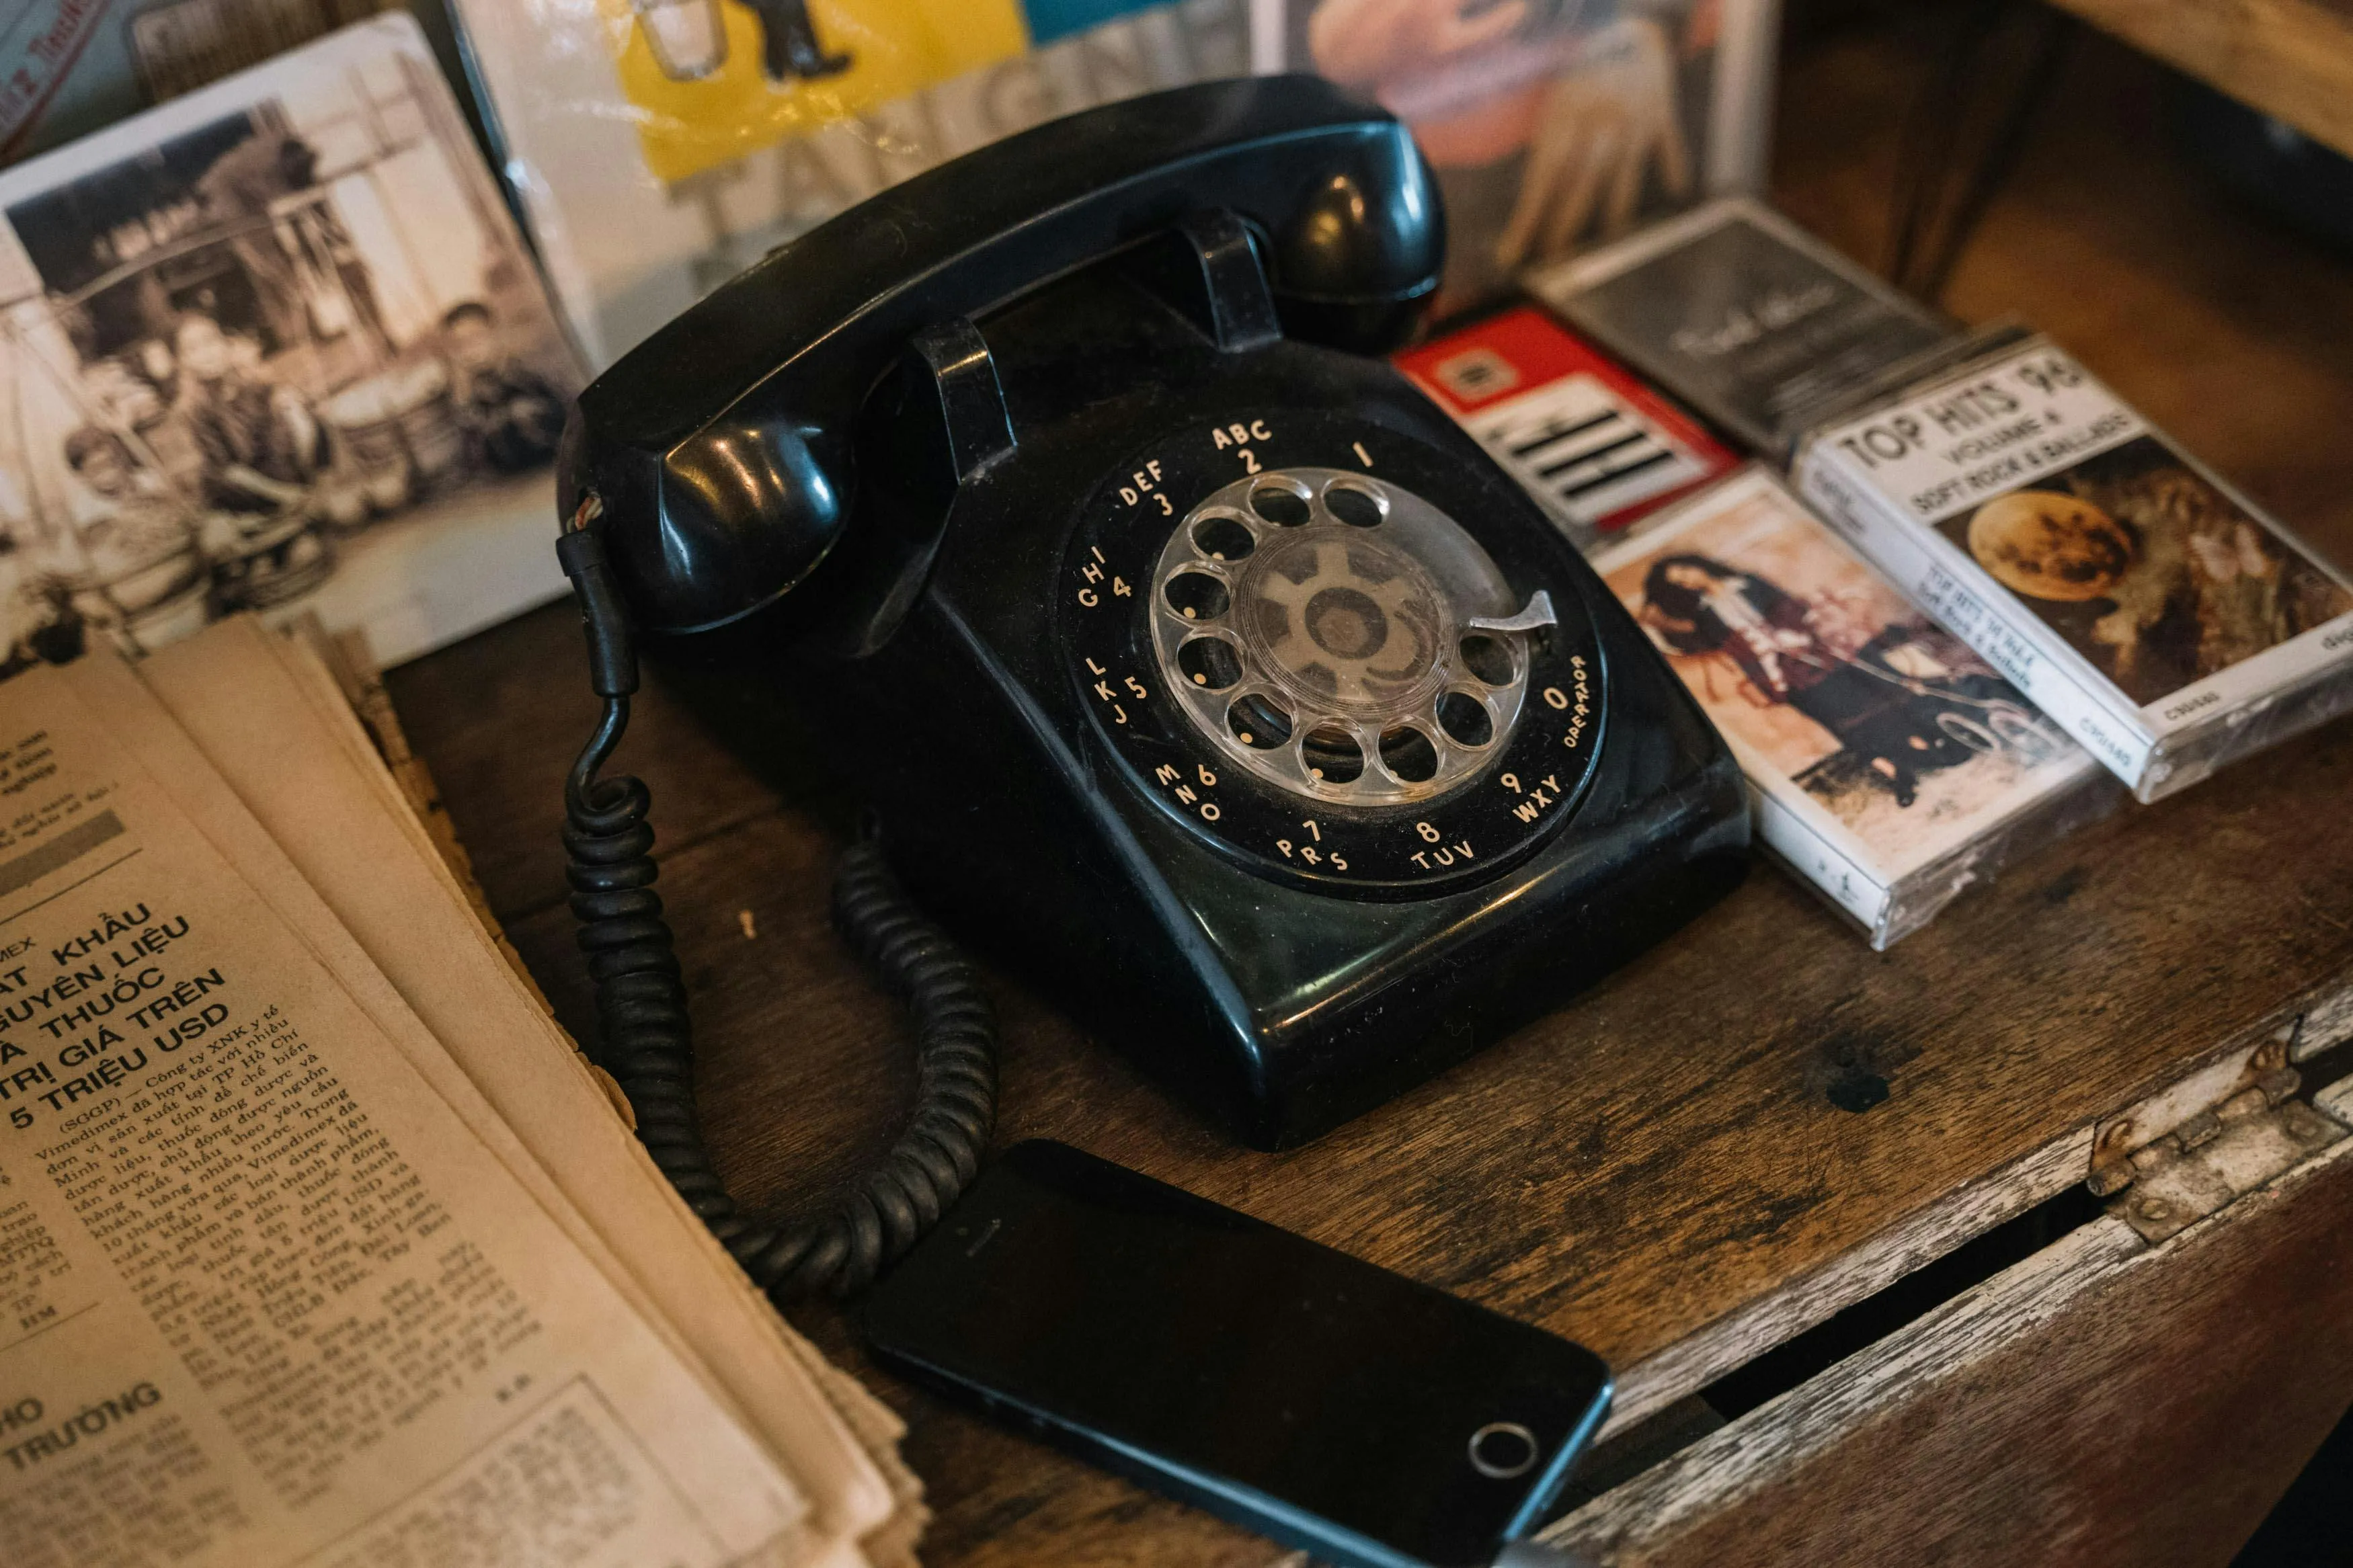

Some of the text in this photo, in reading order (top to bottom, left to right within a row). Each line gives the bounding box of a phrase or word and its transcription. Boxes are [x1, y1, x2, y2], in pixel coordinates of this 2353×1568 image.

[1212, 419, 1272, 450] ABC
[1837, 414, 1925, 468] TOP
[1923, 381, 2021, 436] HITS
[1946, 417, 2042, 466] VOLUME
[1238, 448, 1263, 474] 2
[1352, 441, 1373, 468] 1
[1911, 478, 1960, 515] SOFT
[1964, 456, 2022, 490] ROCK
[2039, 412, 2130, 458] BALLADS
[1119, 459, 1162, 507] DEF
[1153, 493, 1173, 516] 3
[1113, 576, 1131, 597] 4
[1125, 676, 1147, 699] 5
[1564, 655, 1590, 748] OPERATOR
[1198, 764, 1217, 786] 6
[1501, 773, 1522, 794] 9
[1512, 774, 1561, 823] WXY
[1275, 839, 1347, 870] PRS
[1302, 819, 1321, 842] 7
[1416, 821, 1440, 843] 8
[1410, 841, 1474, 870] TUV
[52, 903, 151, 966] KHẨU
[111, 915, 190, 968] LIỆU
[38, 967, 165, 1038] THUỐC
[58, 1024, 126, 1067] GIÁ
[126, 968, 227, 1030] TRÊN
[9, 1003, 229, 1129] 5 TRIỆU USD
[34, 1019, 288, 1160] Vimedimex đã hợp tác với nhiều
[59, 1003, 278, 1133] (SGGP) Công ty XNK y tế
